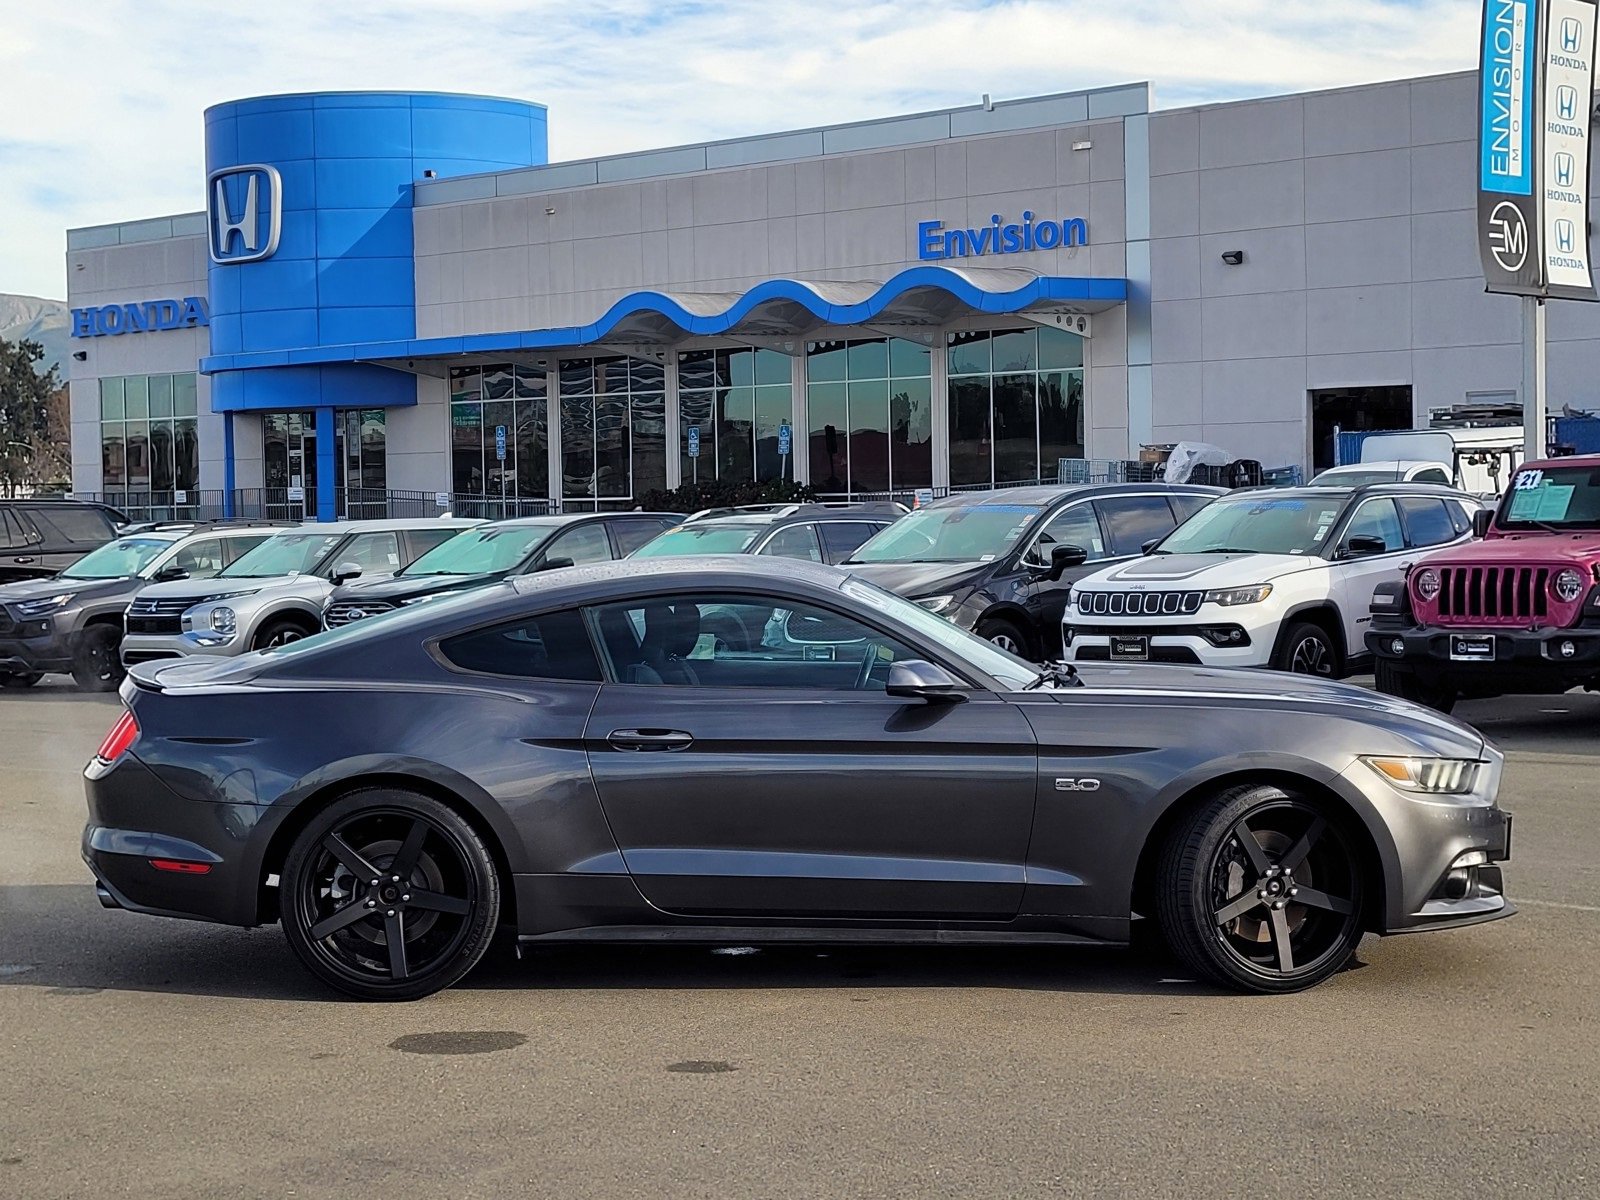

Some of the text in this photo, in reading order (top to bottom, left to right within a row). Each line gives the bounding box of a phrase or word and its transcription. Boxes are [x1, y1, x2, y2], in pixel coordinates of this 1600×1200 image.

[1550, 54, 1588, 72] HONDA
[1491, 0, 1515, 176] ENVISION
[1512, 18, 1523, 162] MOTORS
[1547, 122, 1584, 138] HONDA
[1547, 189, 1582, 204] HONDA
[918, 210, 1089, 261] Envision
[1548, 256, 1585, 270] HONDA
[71, 296, 210, 338] HONDA
[1519, 473, 1538, 487] 21
[1055, 778, 1101, 791] 5.0
